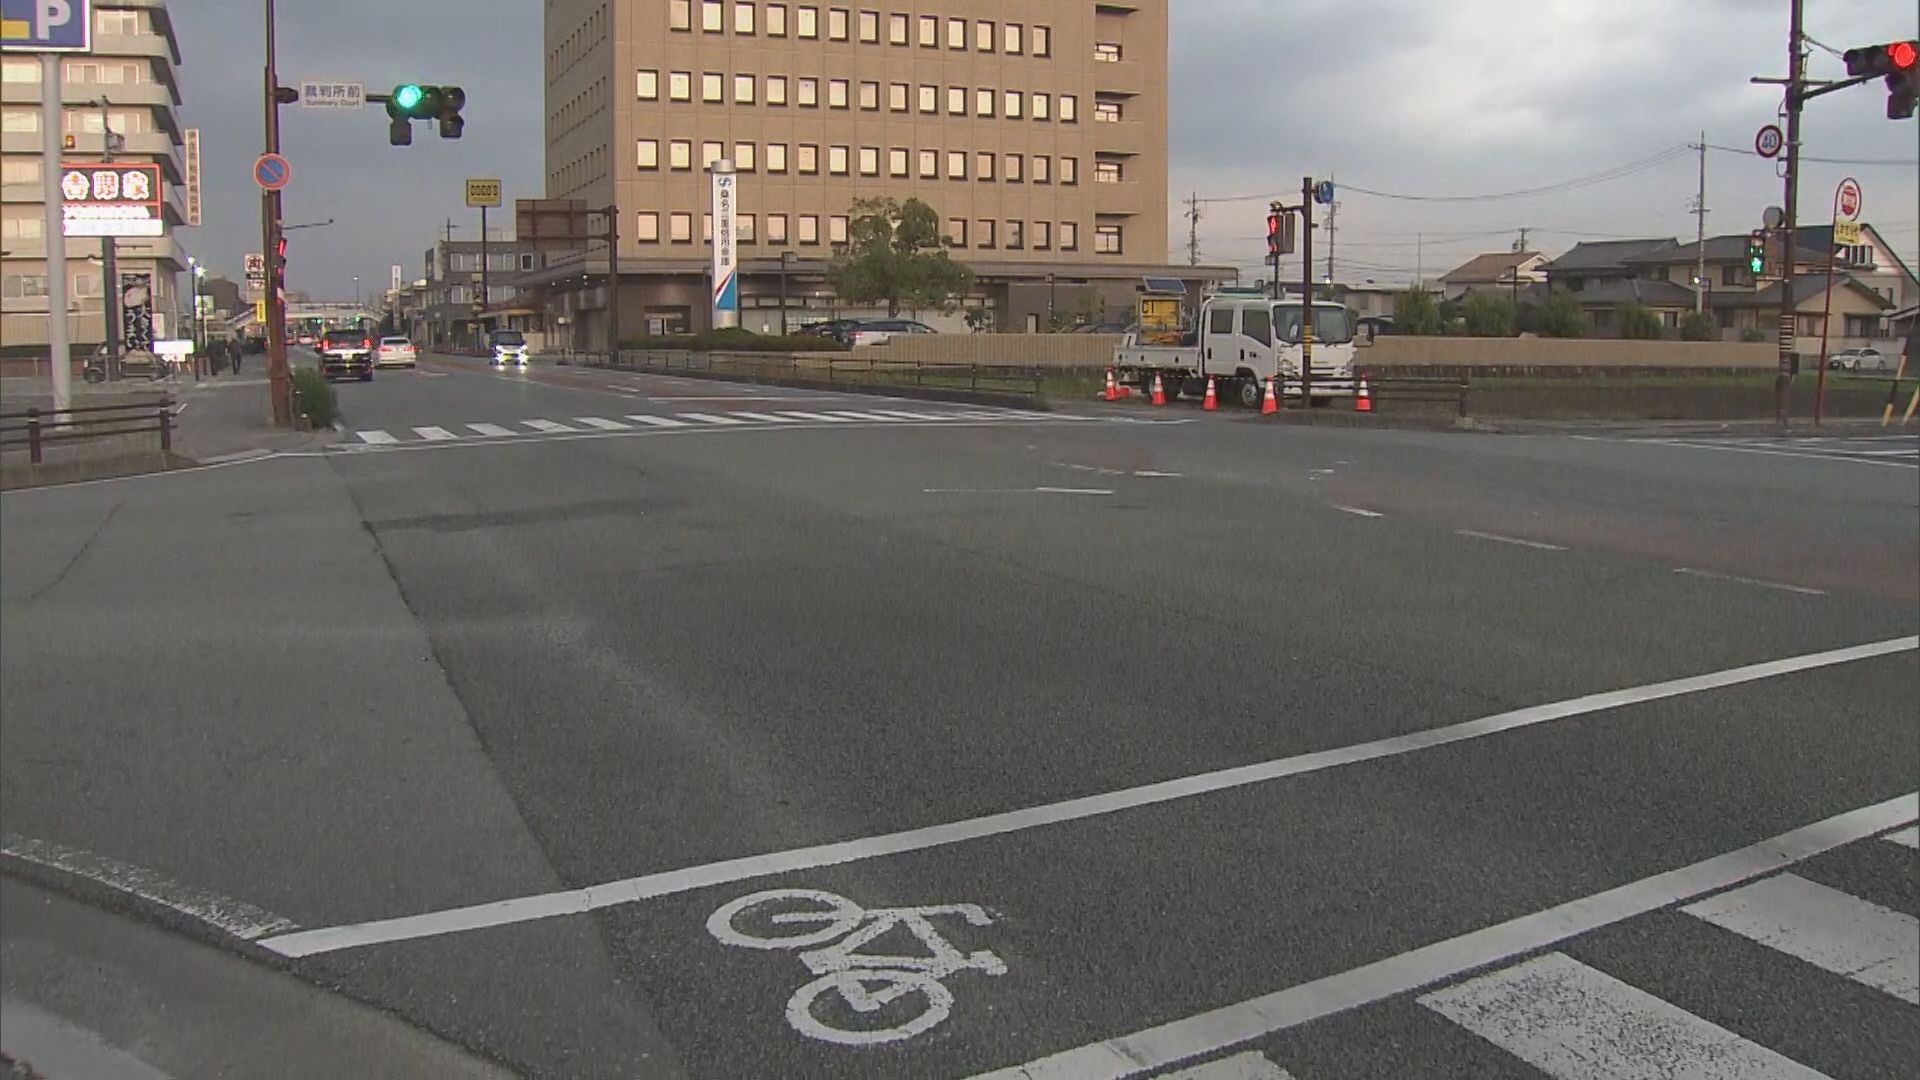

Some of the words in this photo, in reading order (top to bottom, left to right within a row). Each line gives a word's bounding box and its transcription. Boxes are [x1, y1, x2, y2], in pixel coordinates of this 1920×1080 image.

[36, 0, 71, 40] P
[305, 86, 360, 98] 裁判所前
[1762, 134, 1776, 148] 40
